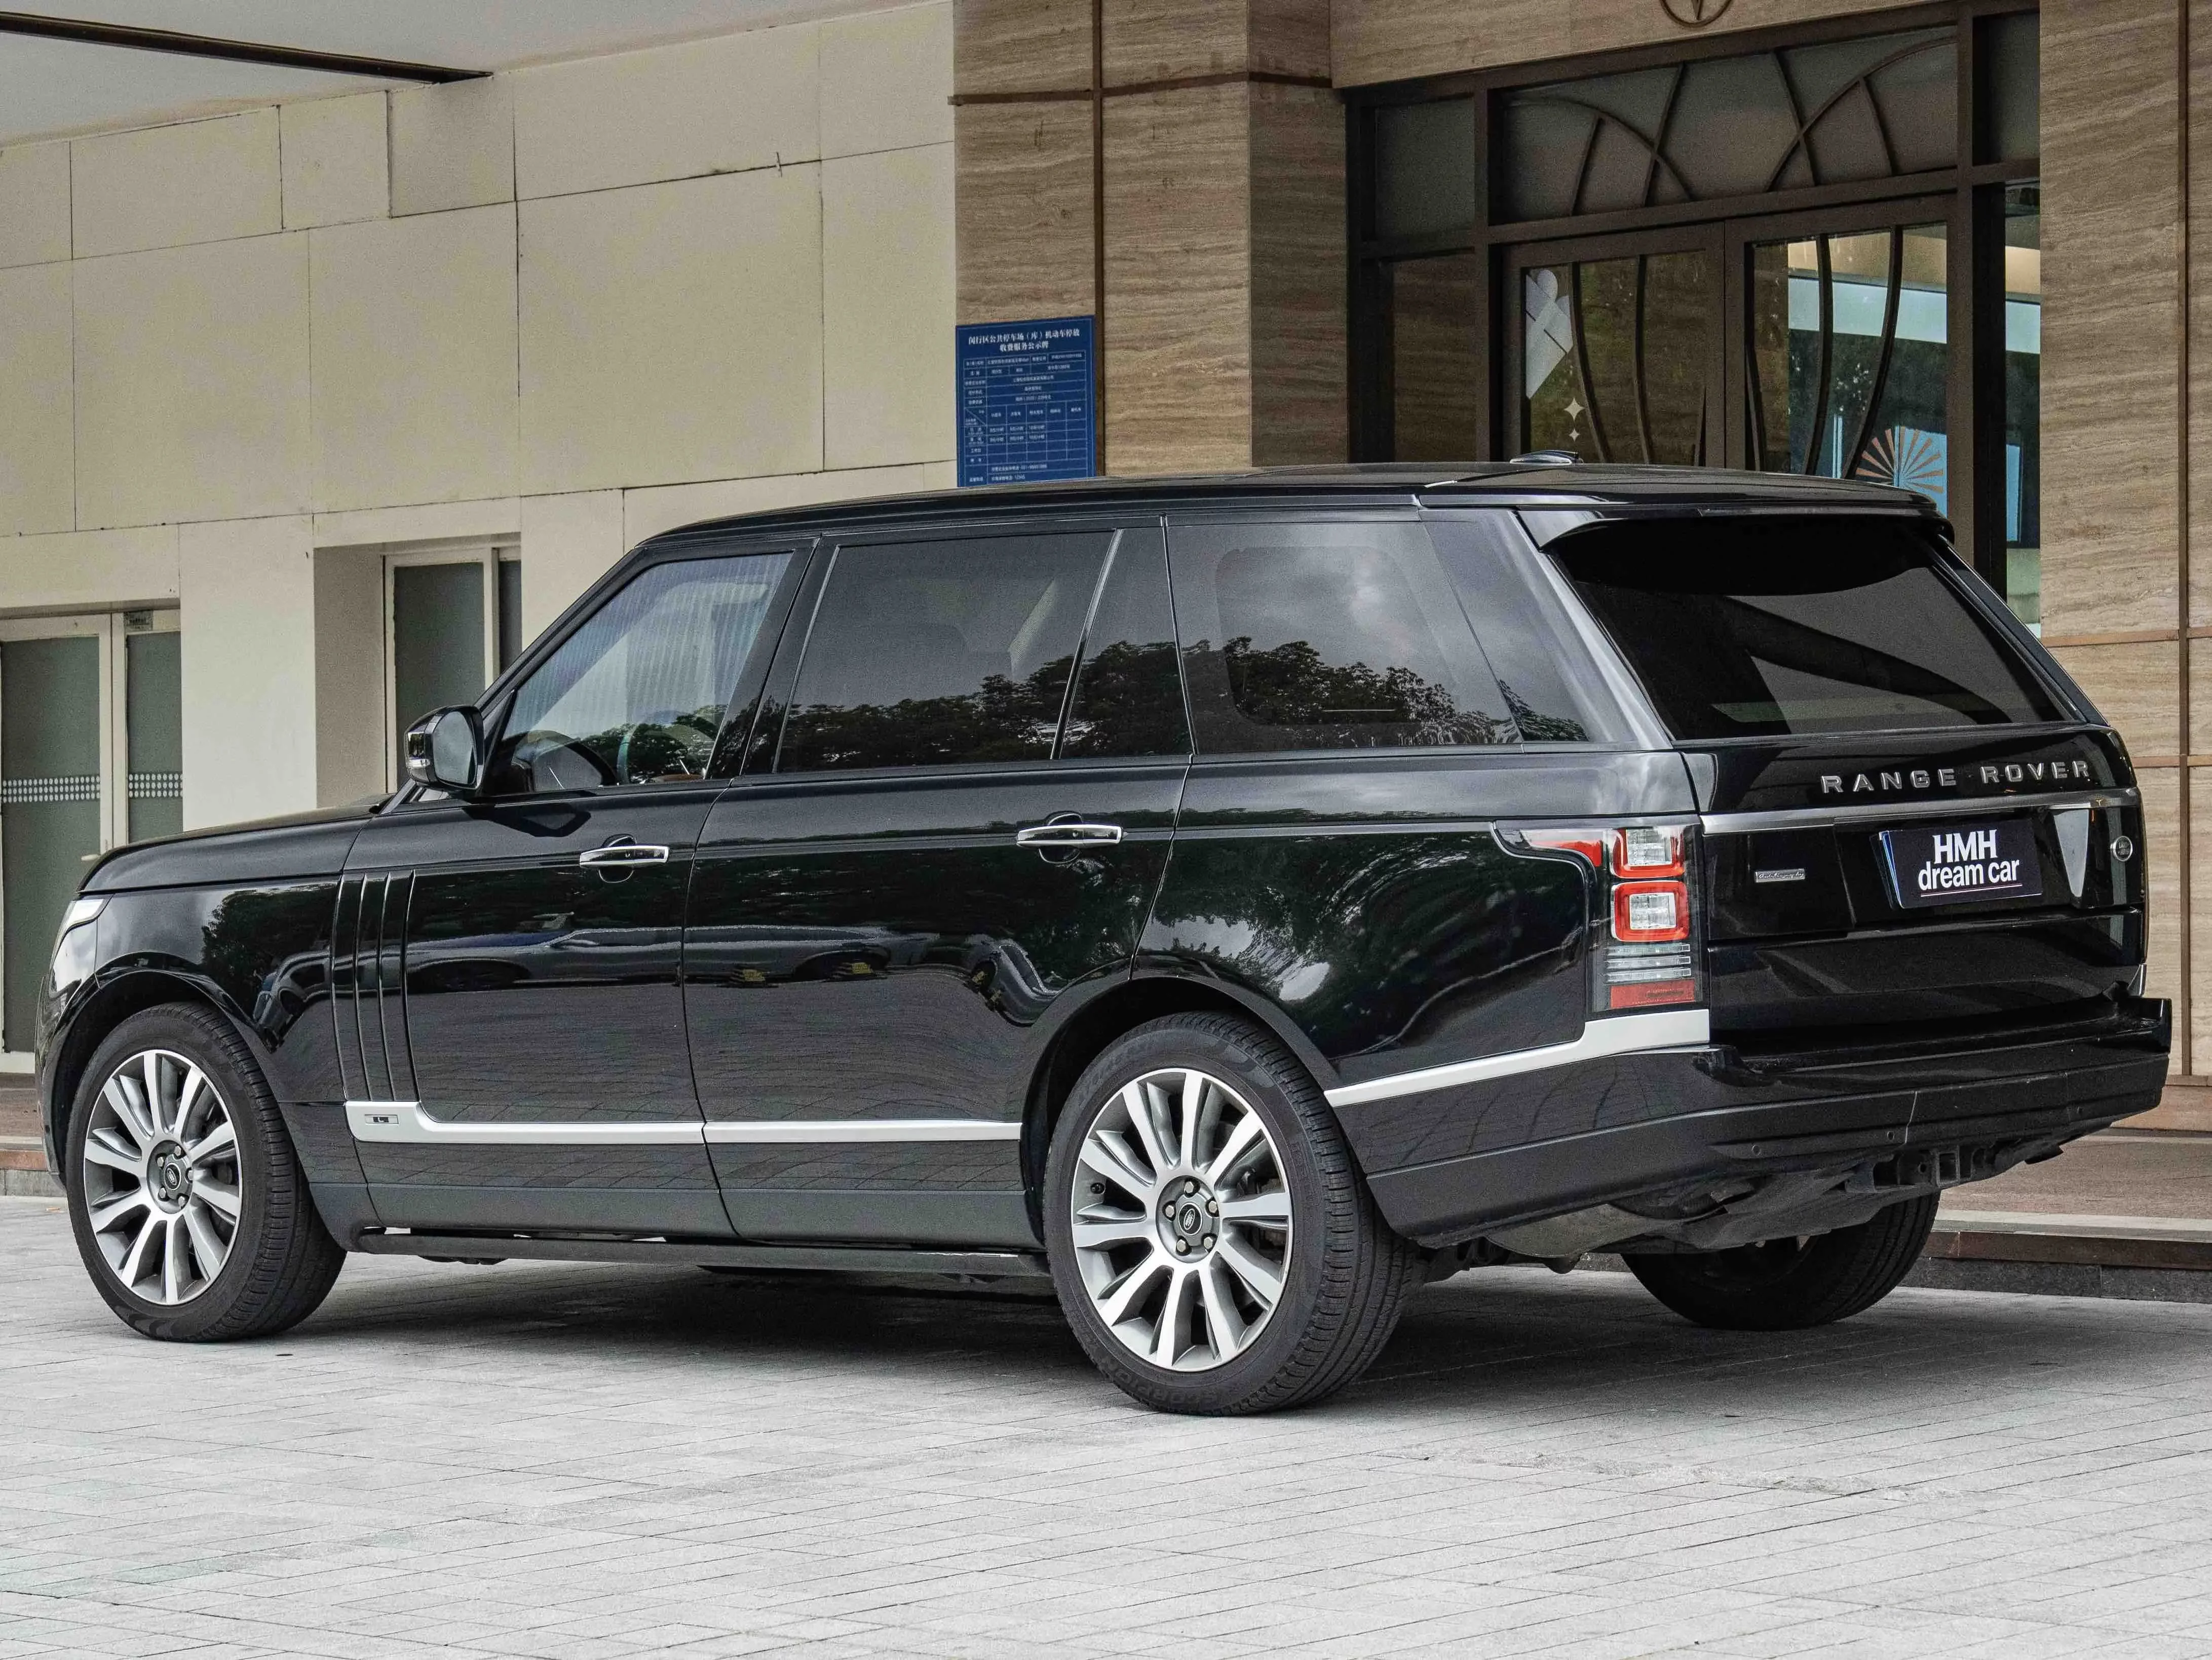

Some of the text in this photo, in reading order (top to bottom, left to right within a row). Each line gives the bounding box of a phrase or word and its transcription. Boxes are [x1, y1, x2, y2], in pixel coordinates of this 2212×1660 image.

[1821, 760, 2090, 794] RANGE ROVER
[1932, 829, 1998, 864] HMH
[1918, 860, 2020, 891] dream car
